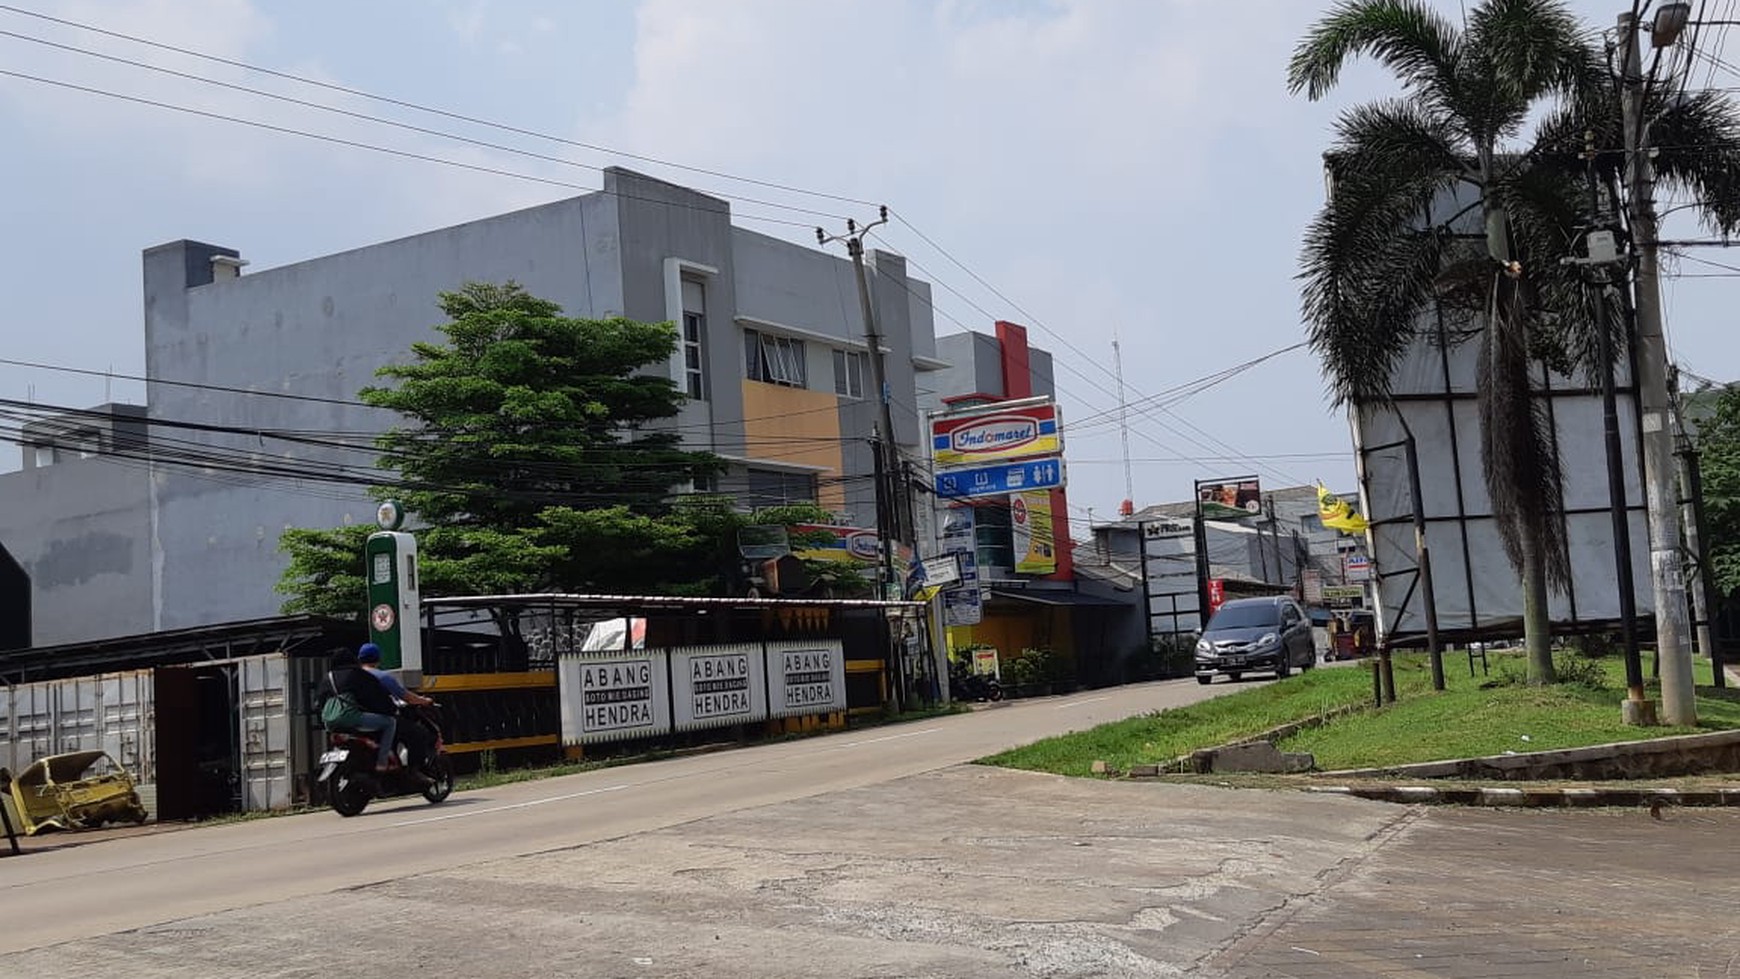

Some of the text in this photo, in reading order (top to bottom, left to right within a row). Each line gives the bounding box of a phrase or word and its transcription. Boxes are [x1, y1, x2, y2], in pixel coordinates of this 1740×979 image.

[958, 425, 1032, 447] Indomaret
[693, 658, 747, 679] ABANG
[785, 653, 830, 672] ABANG
[584, 665, 649, 688] ABANG
[695, 693, 748, 715] HENDRA
[786, 684, 832, 704] HENDRA
[585, 702, 651, 728] HENDRA
